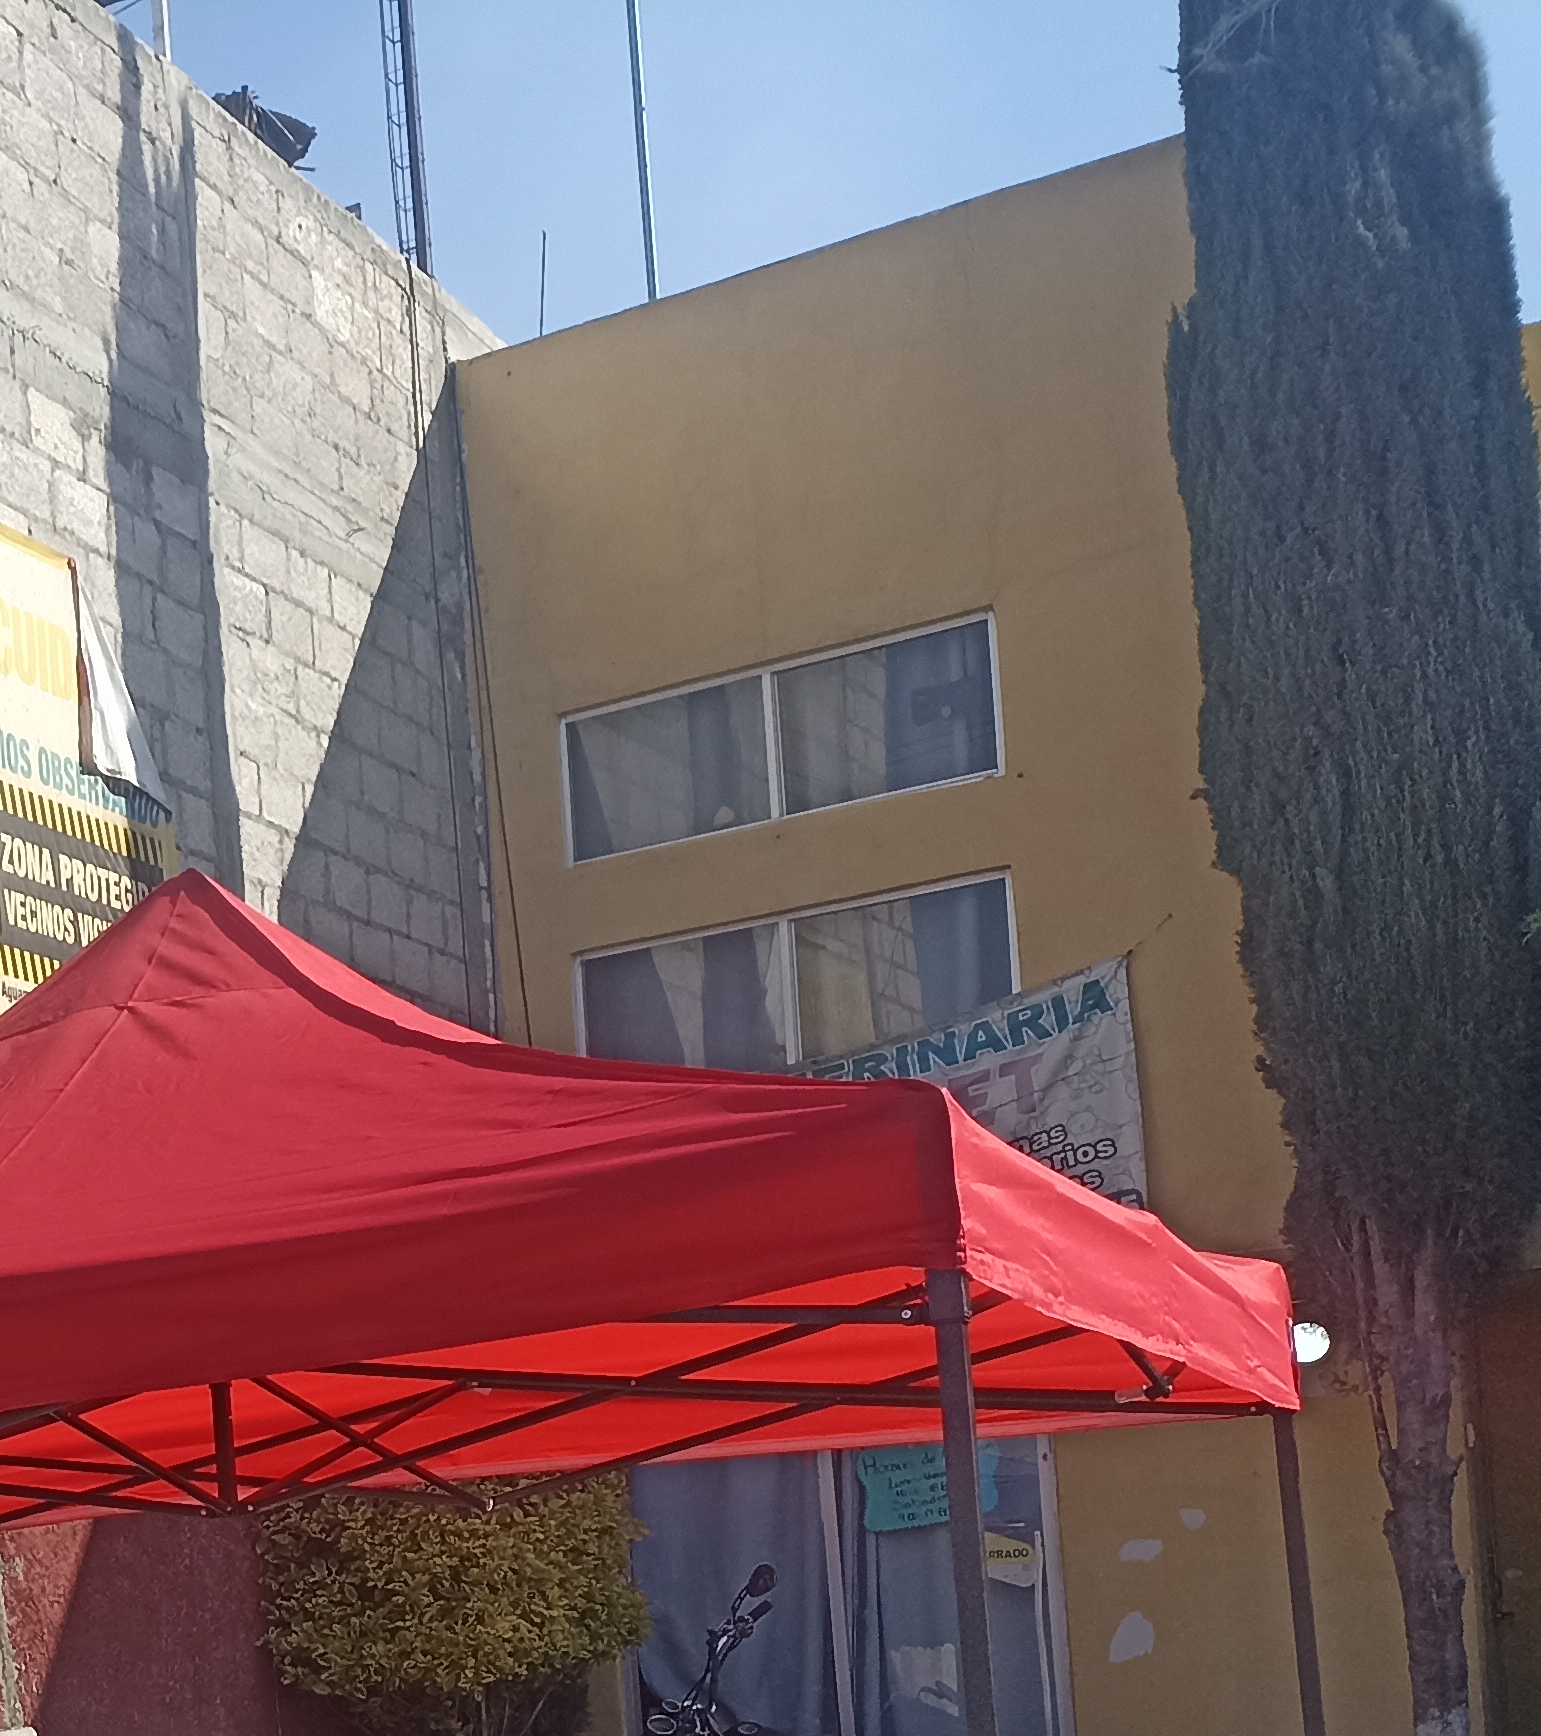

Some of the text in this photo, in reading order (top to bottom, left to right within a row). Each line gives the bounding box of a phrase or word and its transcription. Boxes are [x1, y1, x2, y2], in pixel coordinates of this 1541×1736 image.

[0, 832, 155, 912] ZONA PROTEGID
[4, 889, 74, 944] VECINOS
[989, 1547, 1029, 1559] RRADO
